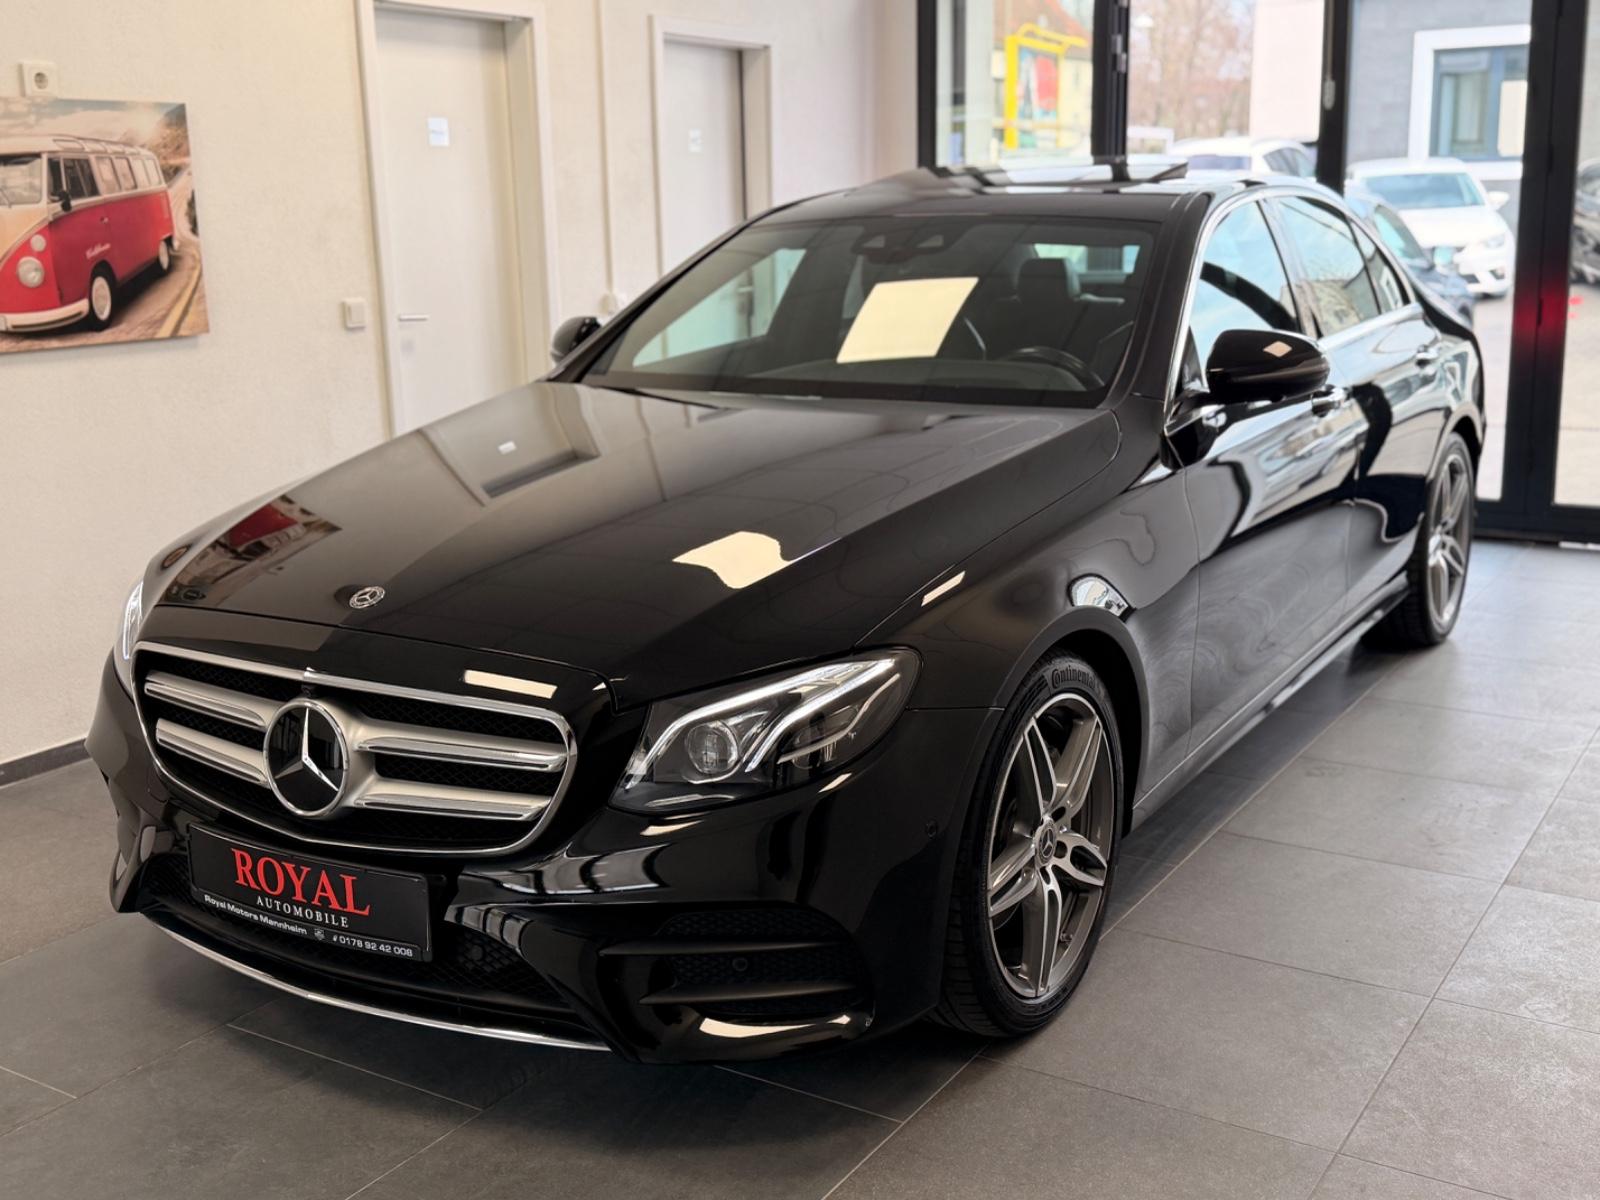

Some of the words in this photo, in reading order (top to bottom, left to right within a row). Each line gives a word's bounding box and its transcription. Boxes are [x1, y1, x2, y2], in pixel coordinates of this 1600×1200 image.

[1051, 664, 1099, 689] Continental
[231, 848, 371, 916] ROYAL
[204, 894, 226, 909] Royal
[227, 903, 259, 921] Motors
[259, 914, 308, 935] Mannheim
[379, 943, 392, 953] 42
[256, 896, 349, 928] AUTOMOBILE
